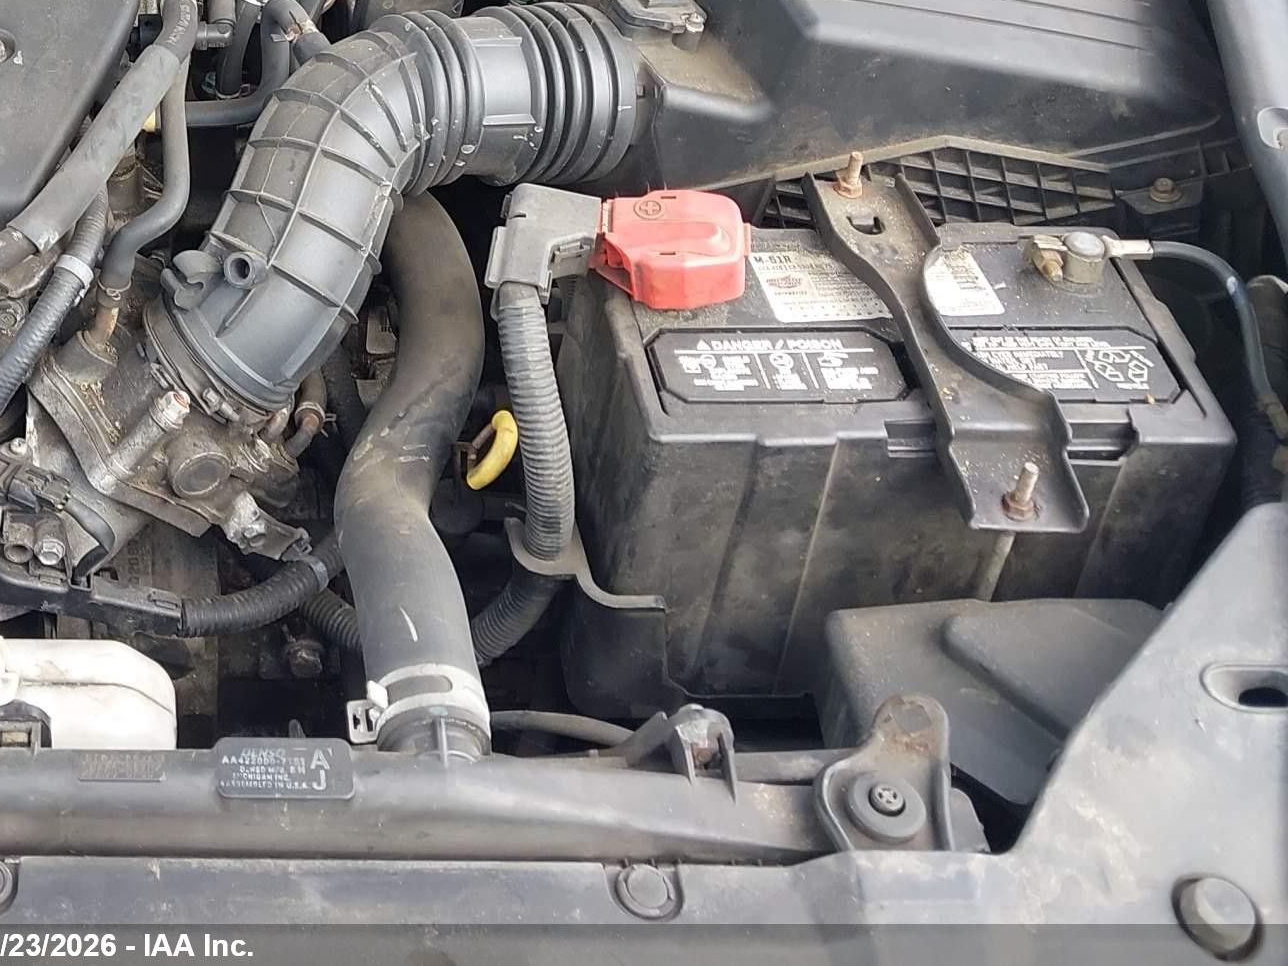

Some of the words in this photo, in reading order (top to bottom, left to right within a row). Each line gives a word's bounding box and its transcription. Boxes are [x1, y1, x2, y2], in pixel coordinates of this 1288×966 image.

[711, 339, 774, 351] DANGER
[787, 338, 844, 350] POISON
[310, 749, 330, 770] A
[311, 769, 327, 791] J
